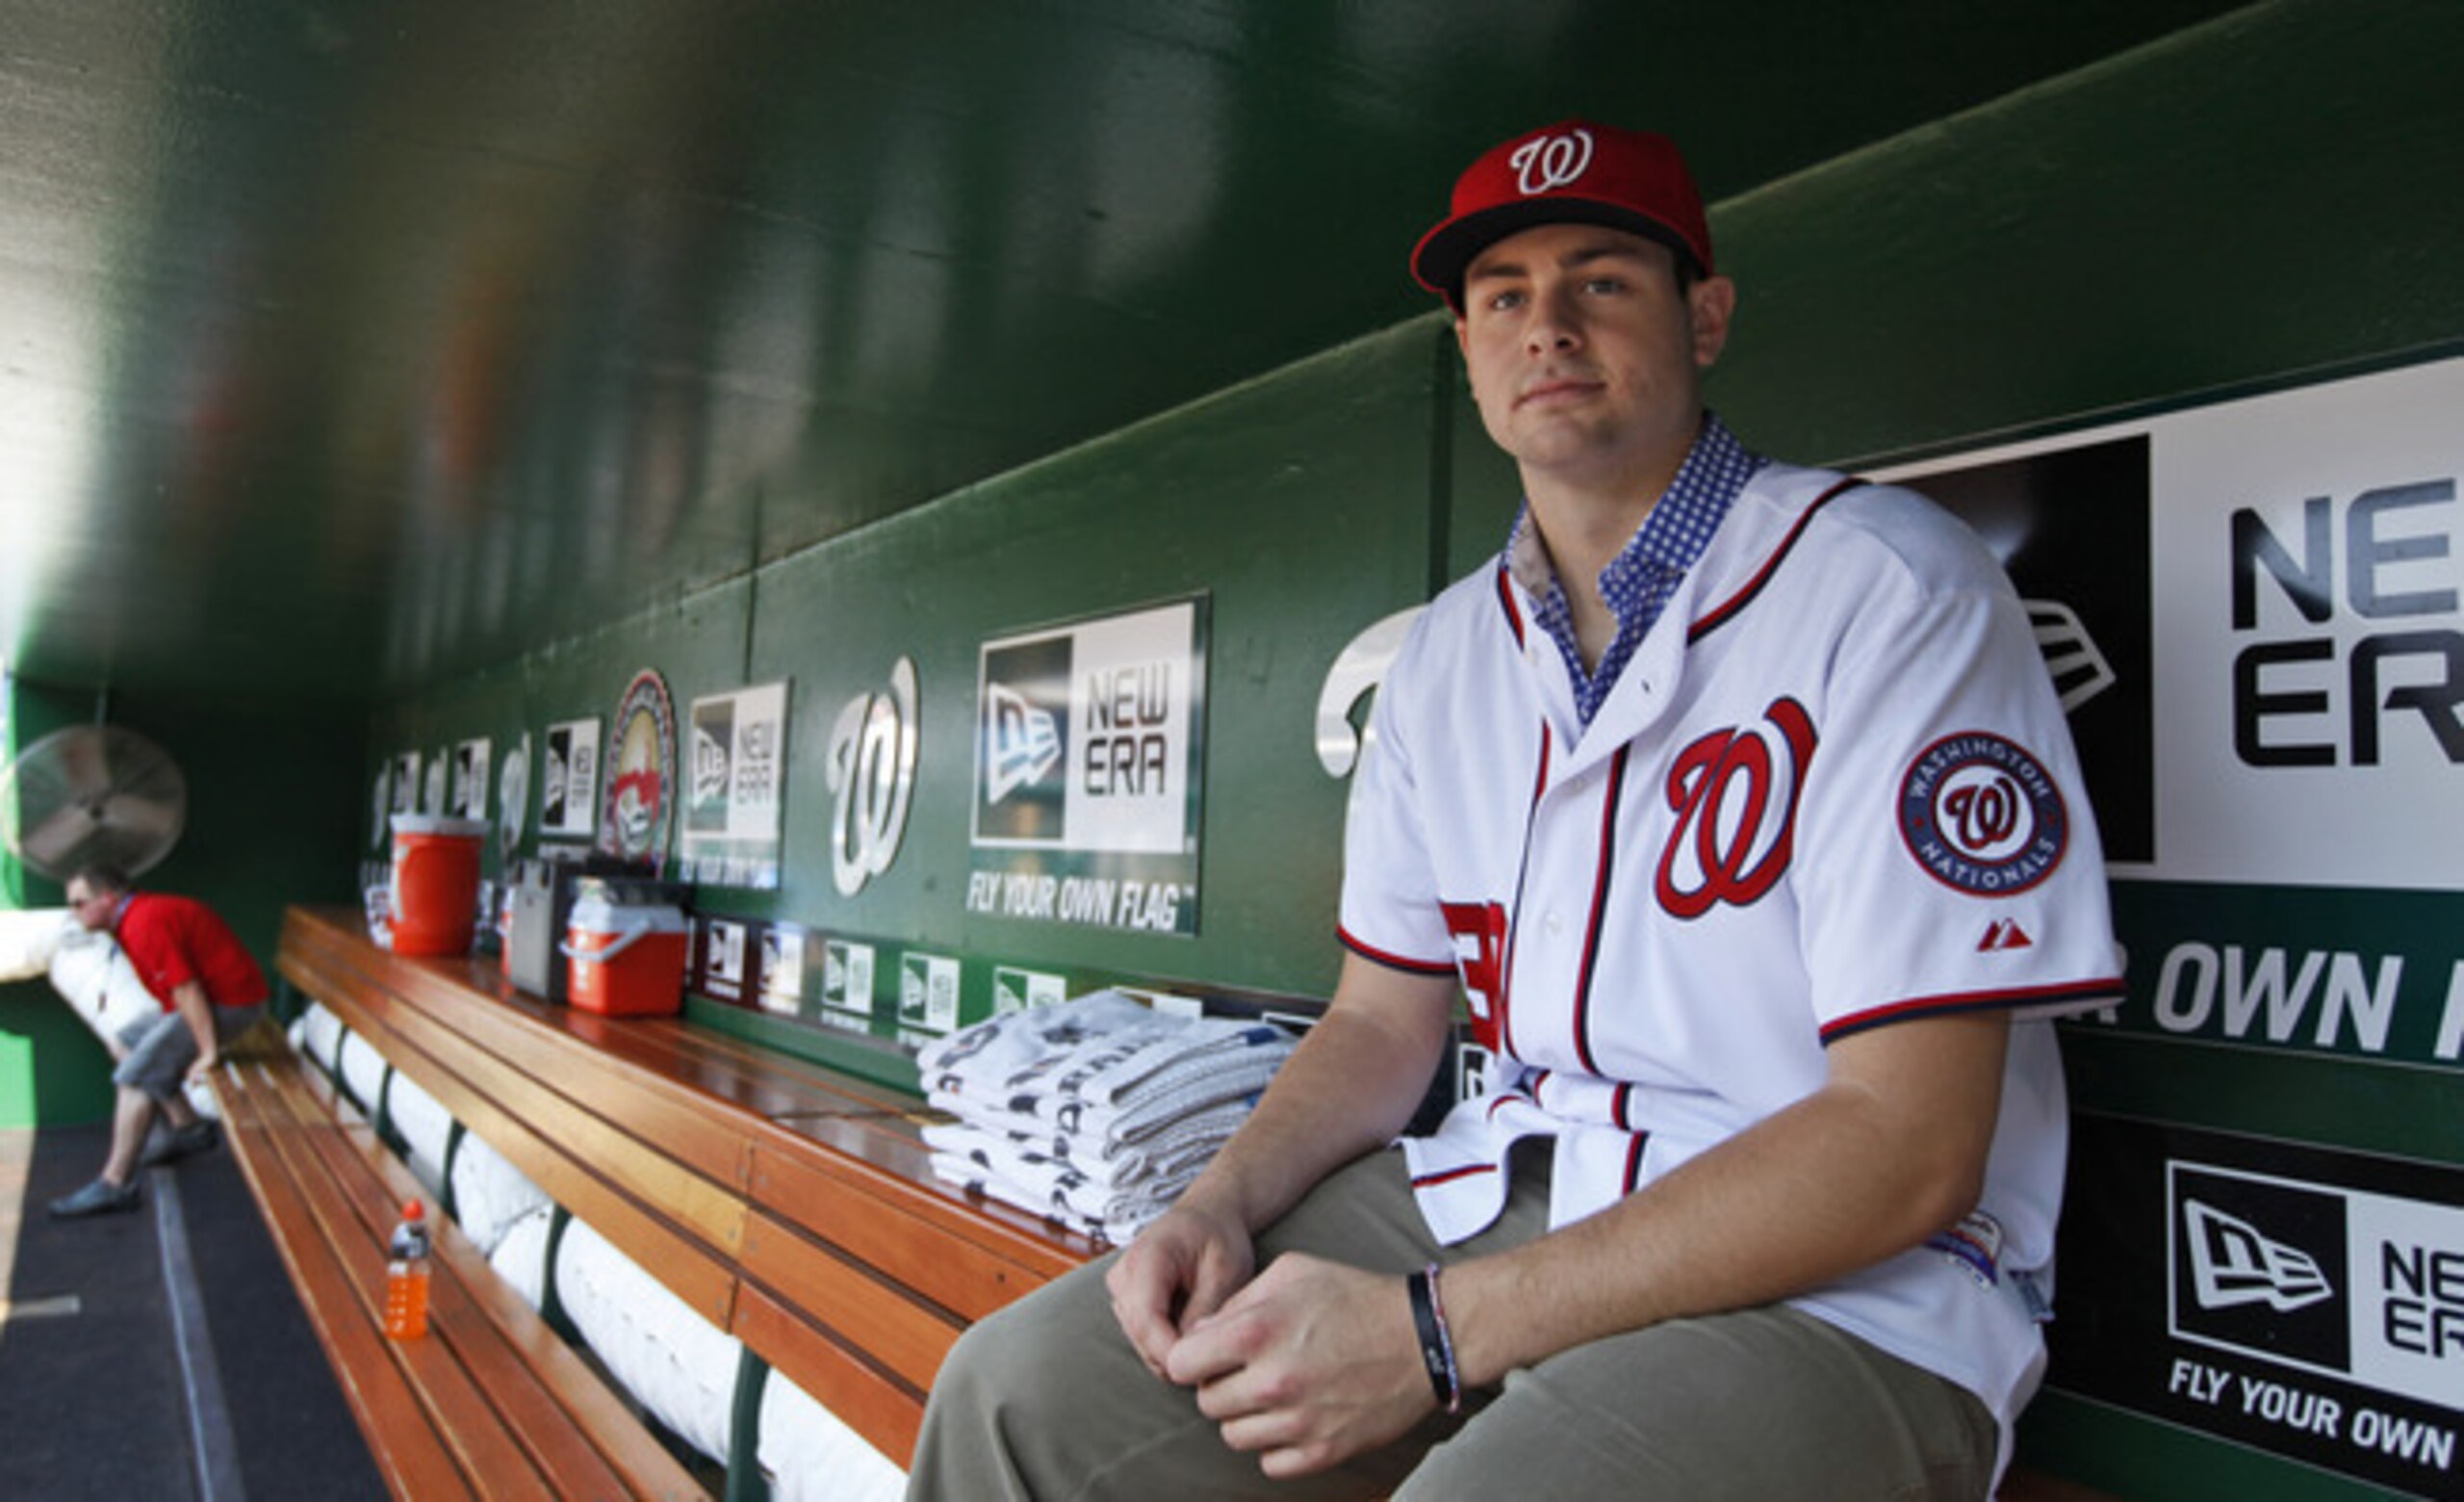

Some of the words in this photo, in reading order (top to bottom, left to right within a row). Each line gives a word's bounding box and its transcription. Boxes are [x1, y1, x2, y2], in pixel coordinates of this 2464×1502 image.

[1509, 128, 1594, 195] W
[1087, 662, 1169, 731] NEW
[1085, 733, 1168, 797] ERA
[1909, 738, 2050, 798] WASHINGTON
[1654, 694, 1819, 921] W
[1943, 776, 2018, 850] W
[1921, 836, 2056, 890] NATIONALS
[966, 870, 1001, 913] FLY
[1004, 873, 1057, 919] YOUR
[1060, 877, 1116, 925] OWN
[2153, 941, 2404, 1052] OWN
[2169, 1360, 2231, 1404] FLY
[2240, 1376, 2342, 1438] YOUR
[2351, 1409, 2454, 1470] OWN
